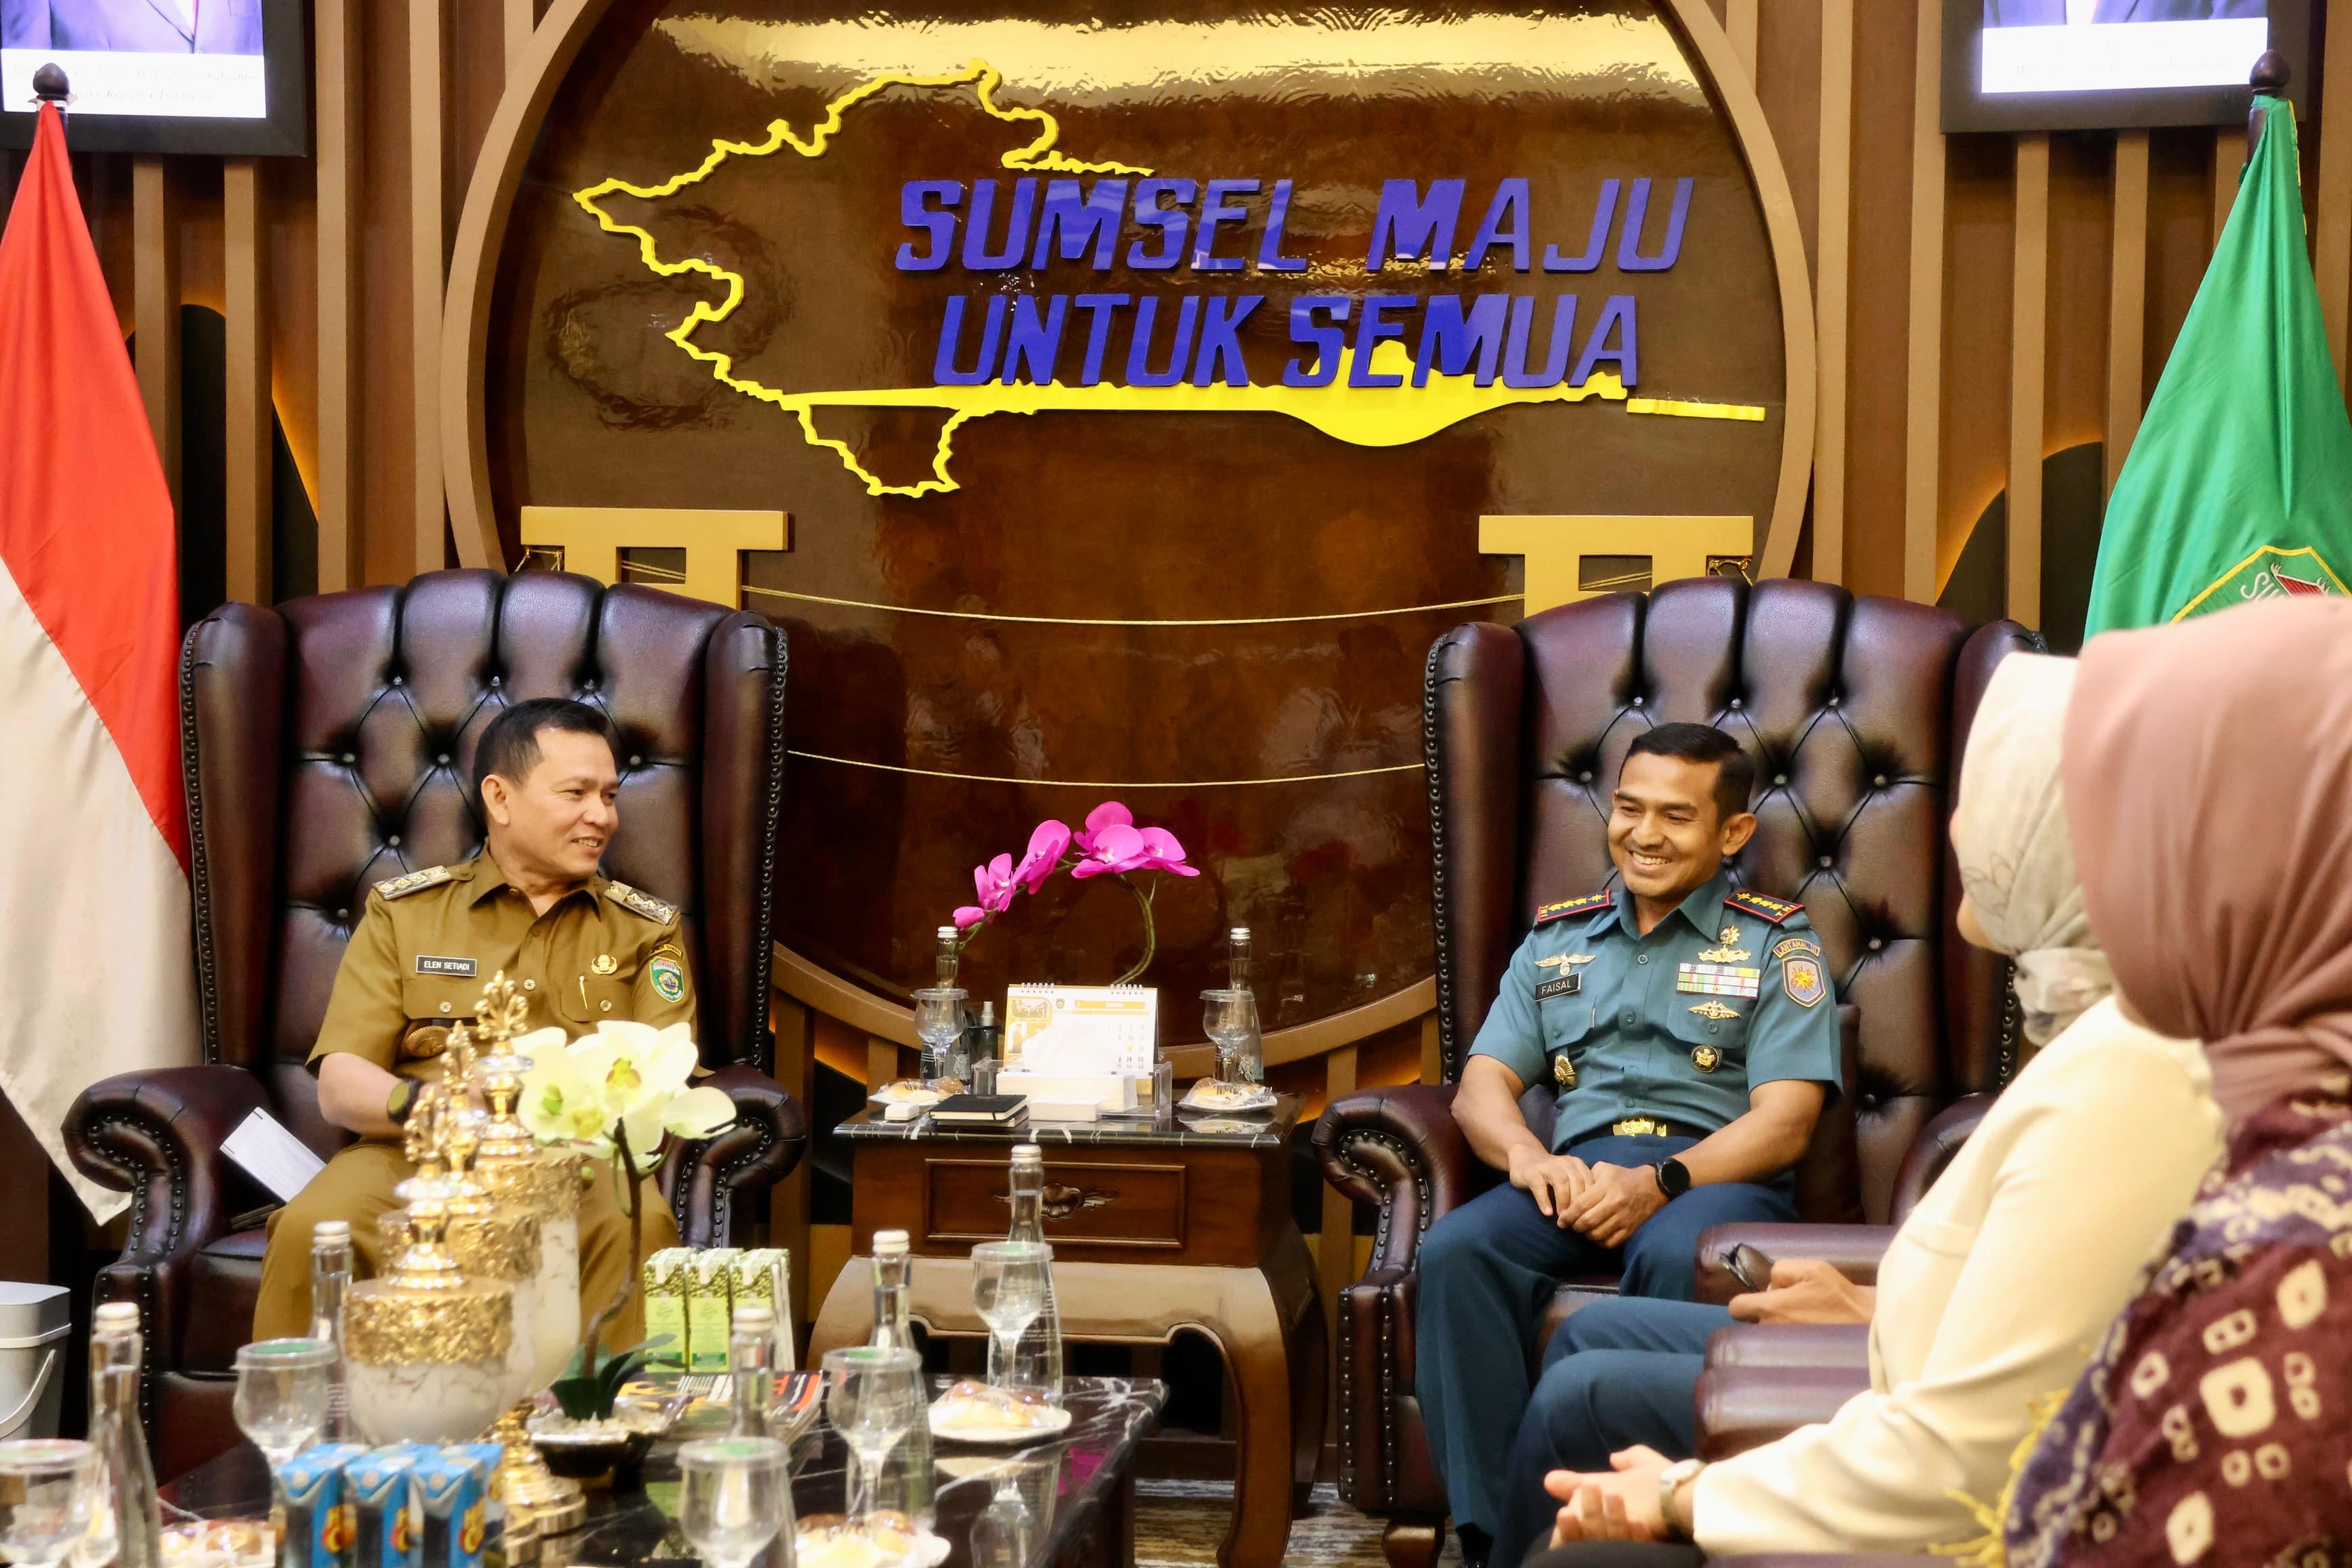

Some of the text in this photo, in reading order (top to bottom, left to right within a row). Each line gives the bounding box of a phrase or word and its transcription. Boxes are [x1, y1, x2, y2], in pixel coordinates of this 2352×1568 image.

[895, 178, 1694, 272] SUMSEL MAJU
[933, 293, 1637, 388] UNTUK SEMUA
[424, 960, 470, 971] ELEN SETIADI
[1542, 979, 1571, 995] FAISAL
